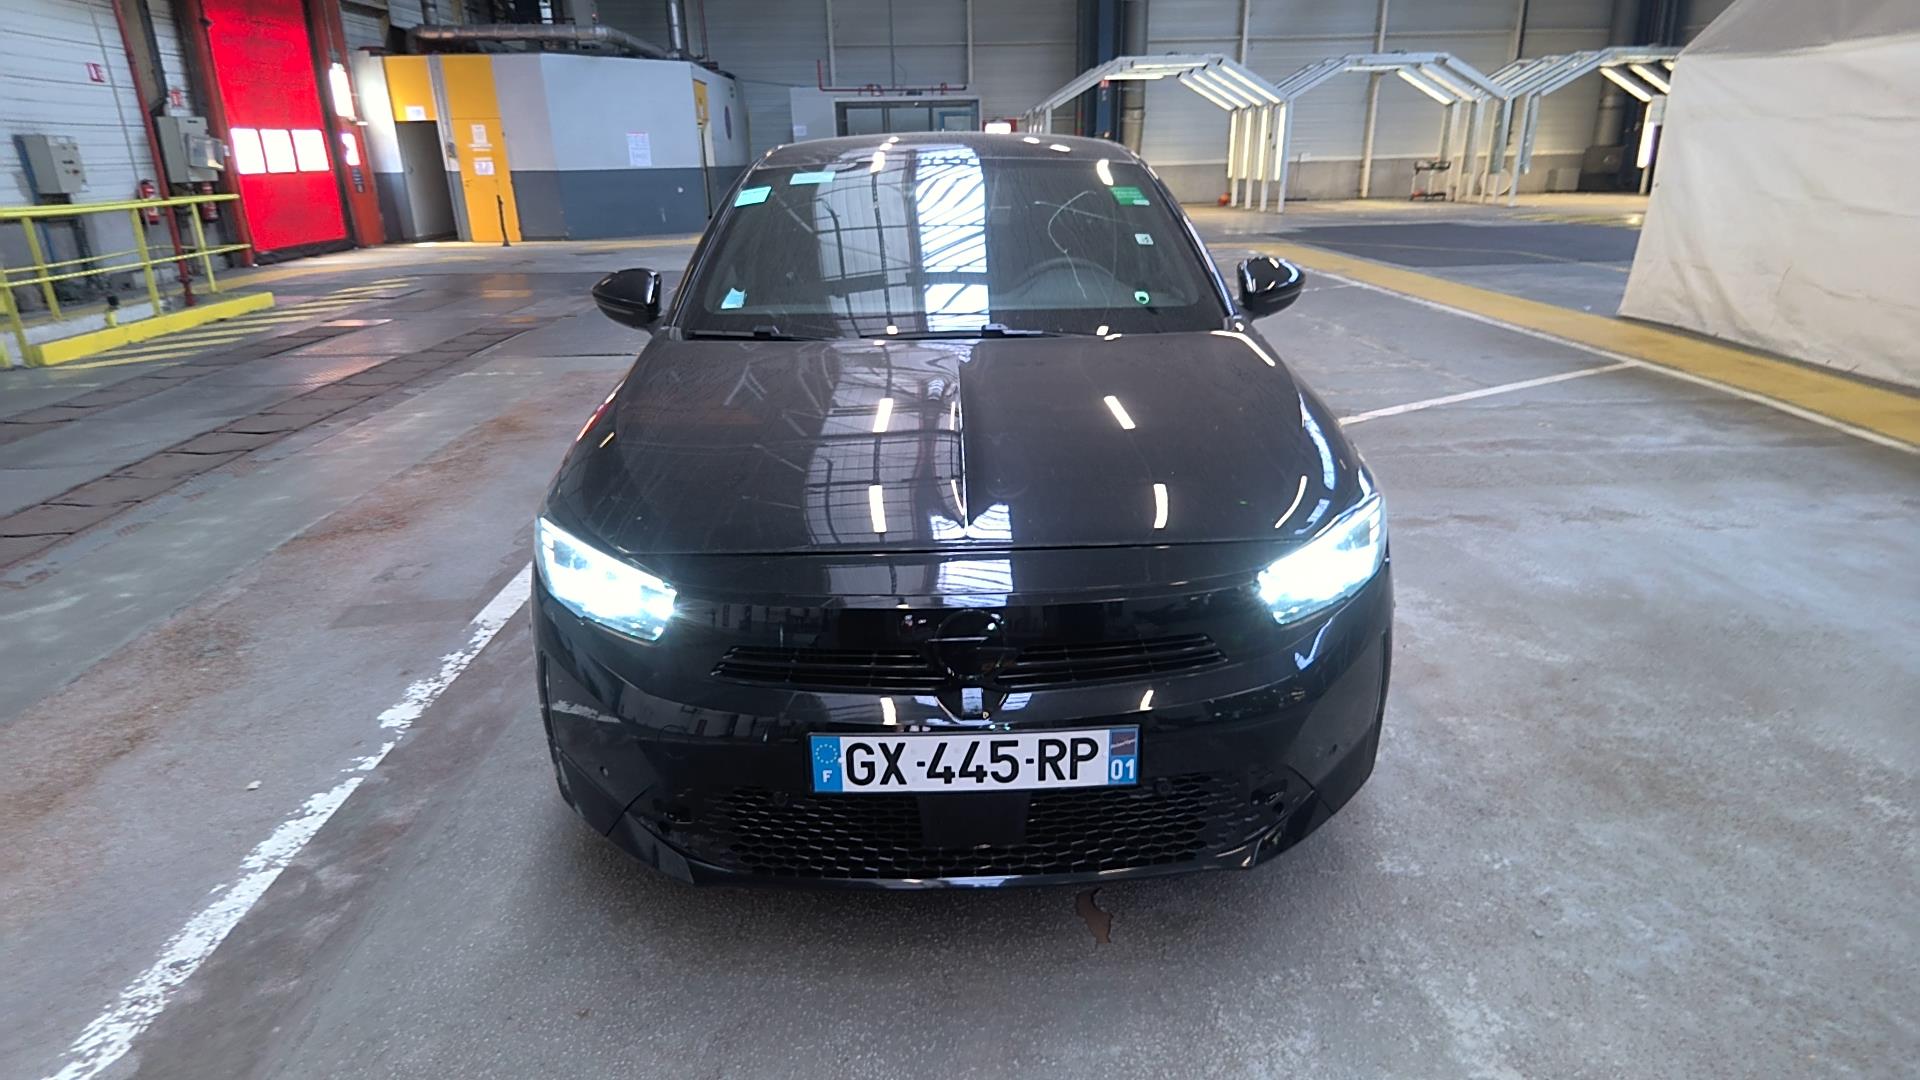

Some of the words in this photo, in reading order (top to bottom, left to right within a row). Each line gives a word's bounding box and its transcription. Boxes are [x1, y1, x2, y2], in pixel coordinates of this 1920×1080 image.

[845, 737, 1099, 786] GX-445-RP
[1111, 758, 1135, 780] 01
[822, 769, 833, 783] F
